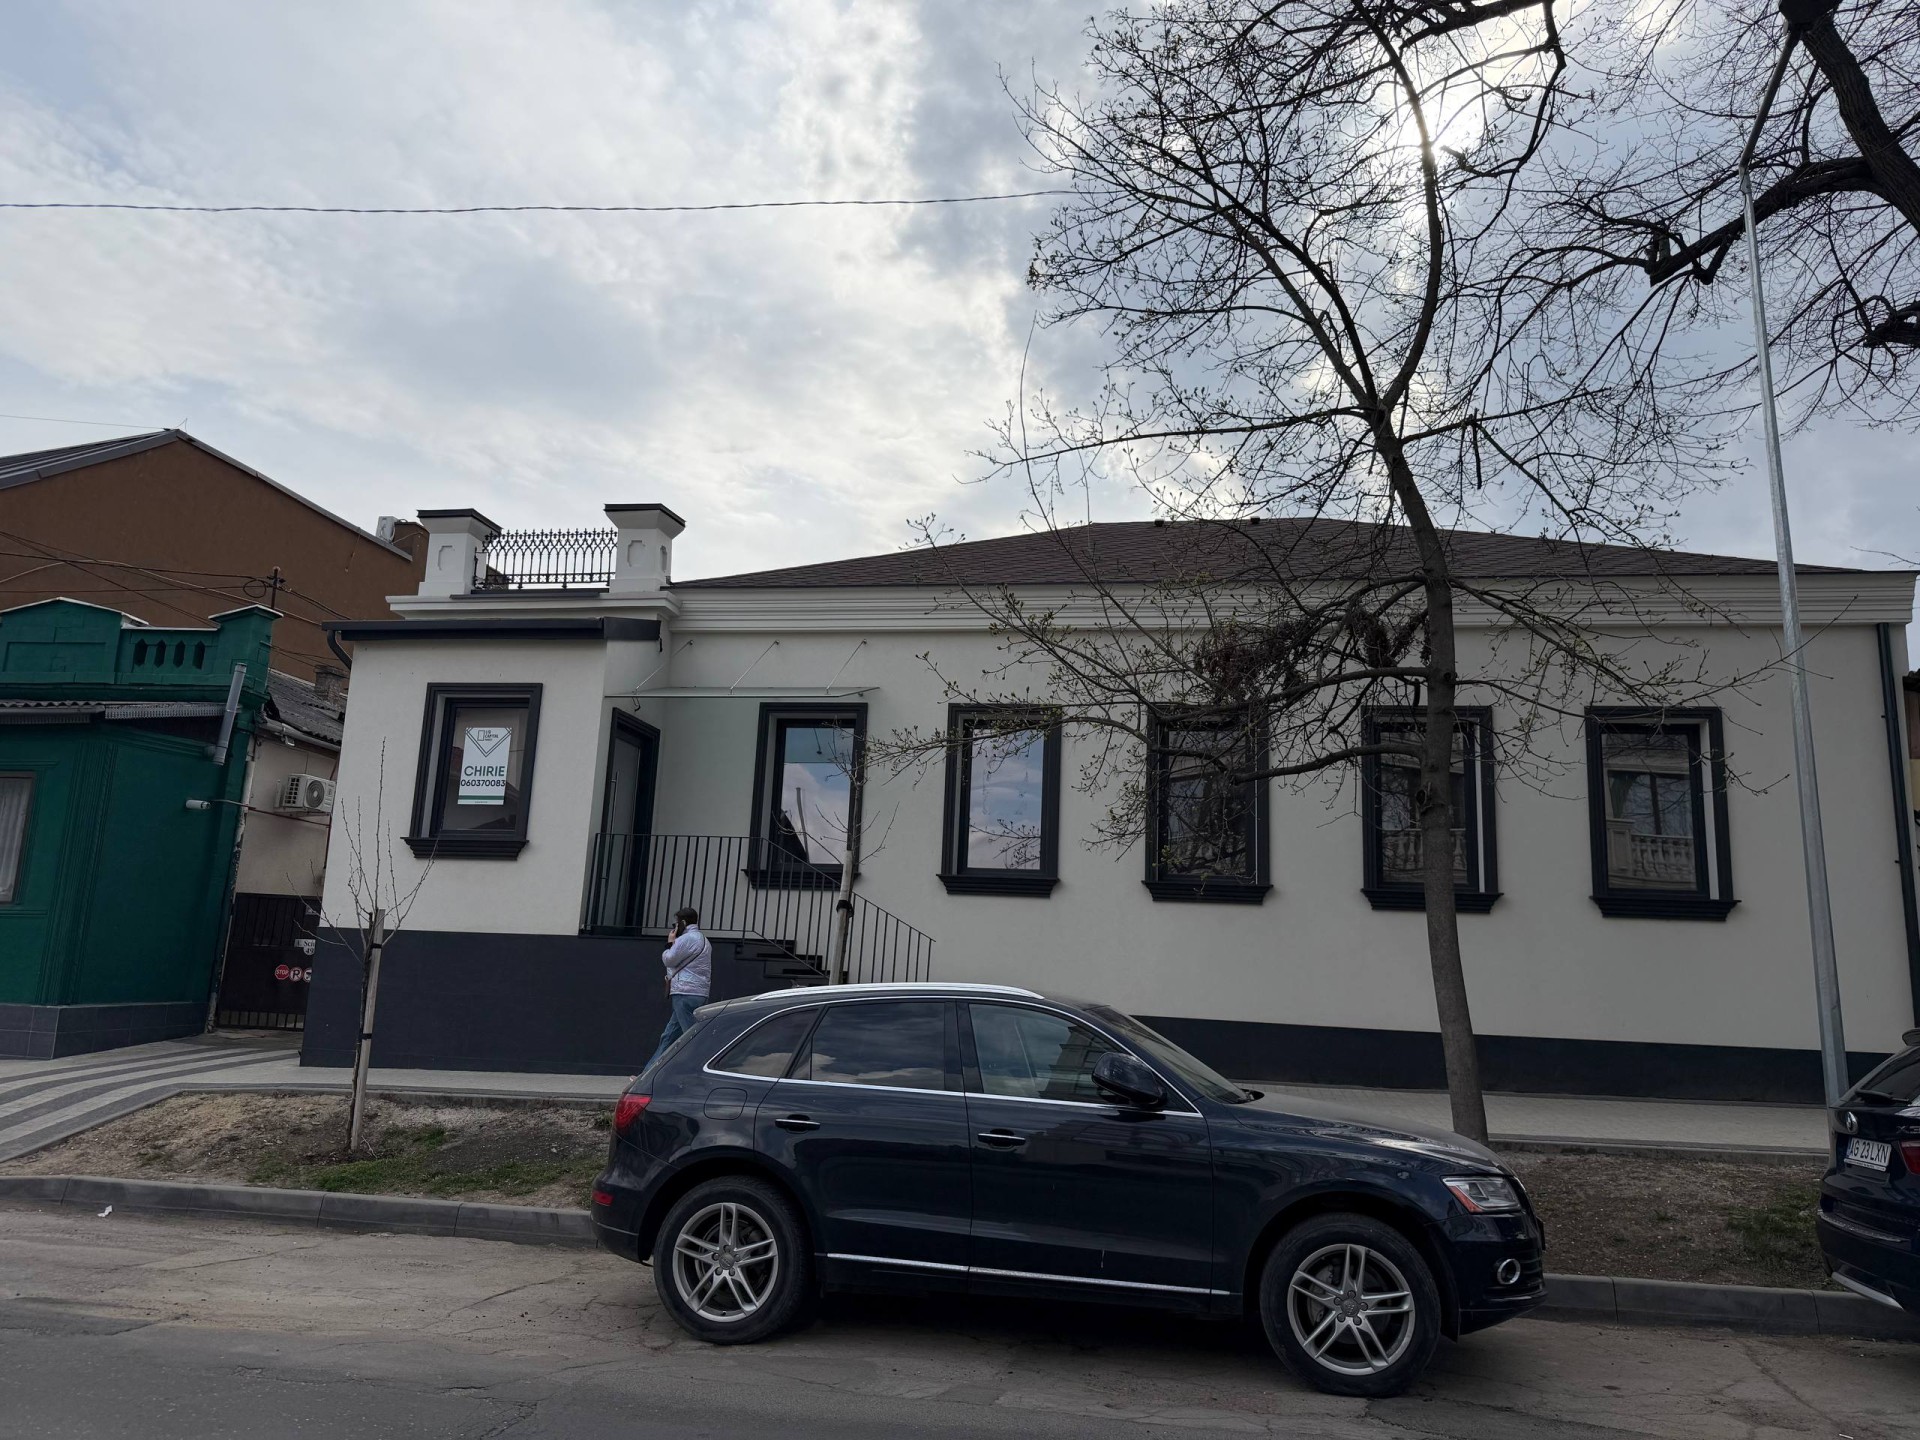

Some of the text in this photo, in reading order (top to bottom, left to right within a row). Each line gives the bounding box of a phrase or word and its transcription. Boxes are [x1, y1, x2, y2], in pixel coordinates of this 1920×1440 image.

[464, 765, 505, 777] CHIRIE
[460, 779, 506, 787] 060370083
[1860, 1141, 1871, 1159] 23
